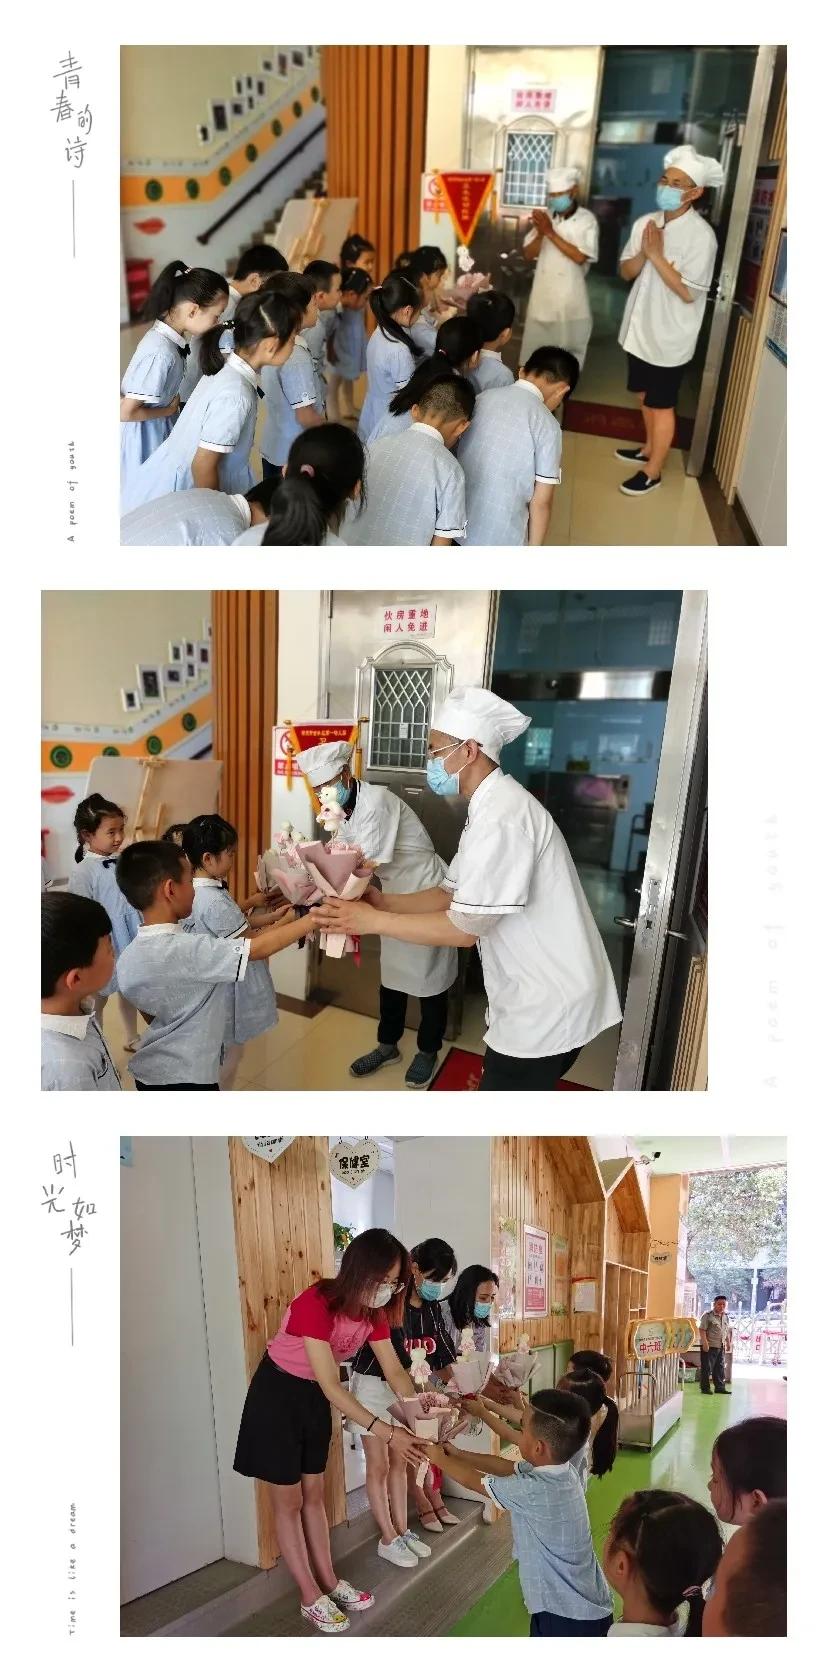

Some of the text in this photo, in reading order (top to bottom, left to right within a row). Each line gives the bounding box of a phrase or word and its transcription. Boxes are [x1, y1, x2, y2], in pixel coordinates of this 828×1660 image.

[384, 608, 429, 620] 伙房重地
[383, 621, 428, 632] 闲人免进
[338, 1155, 370, 1170] 保健室
